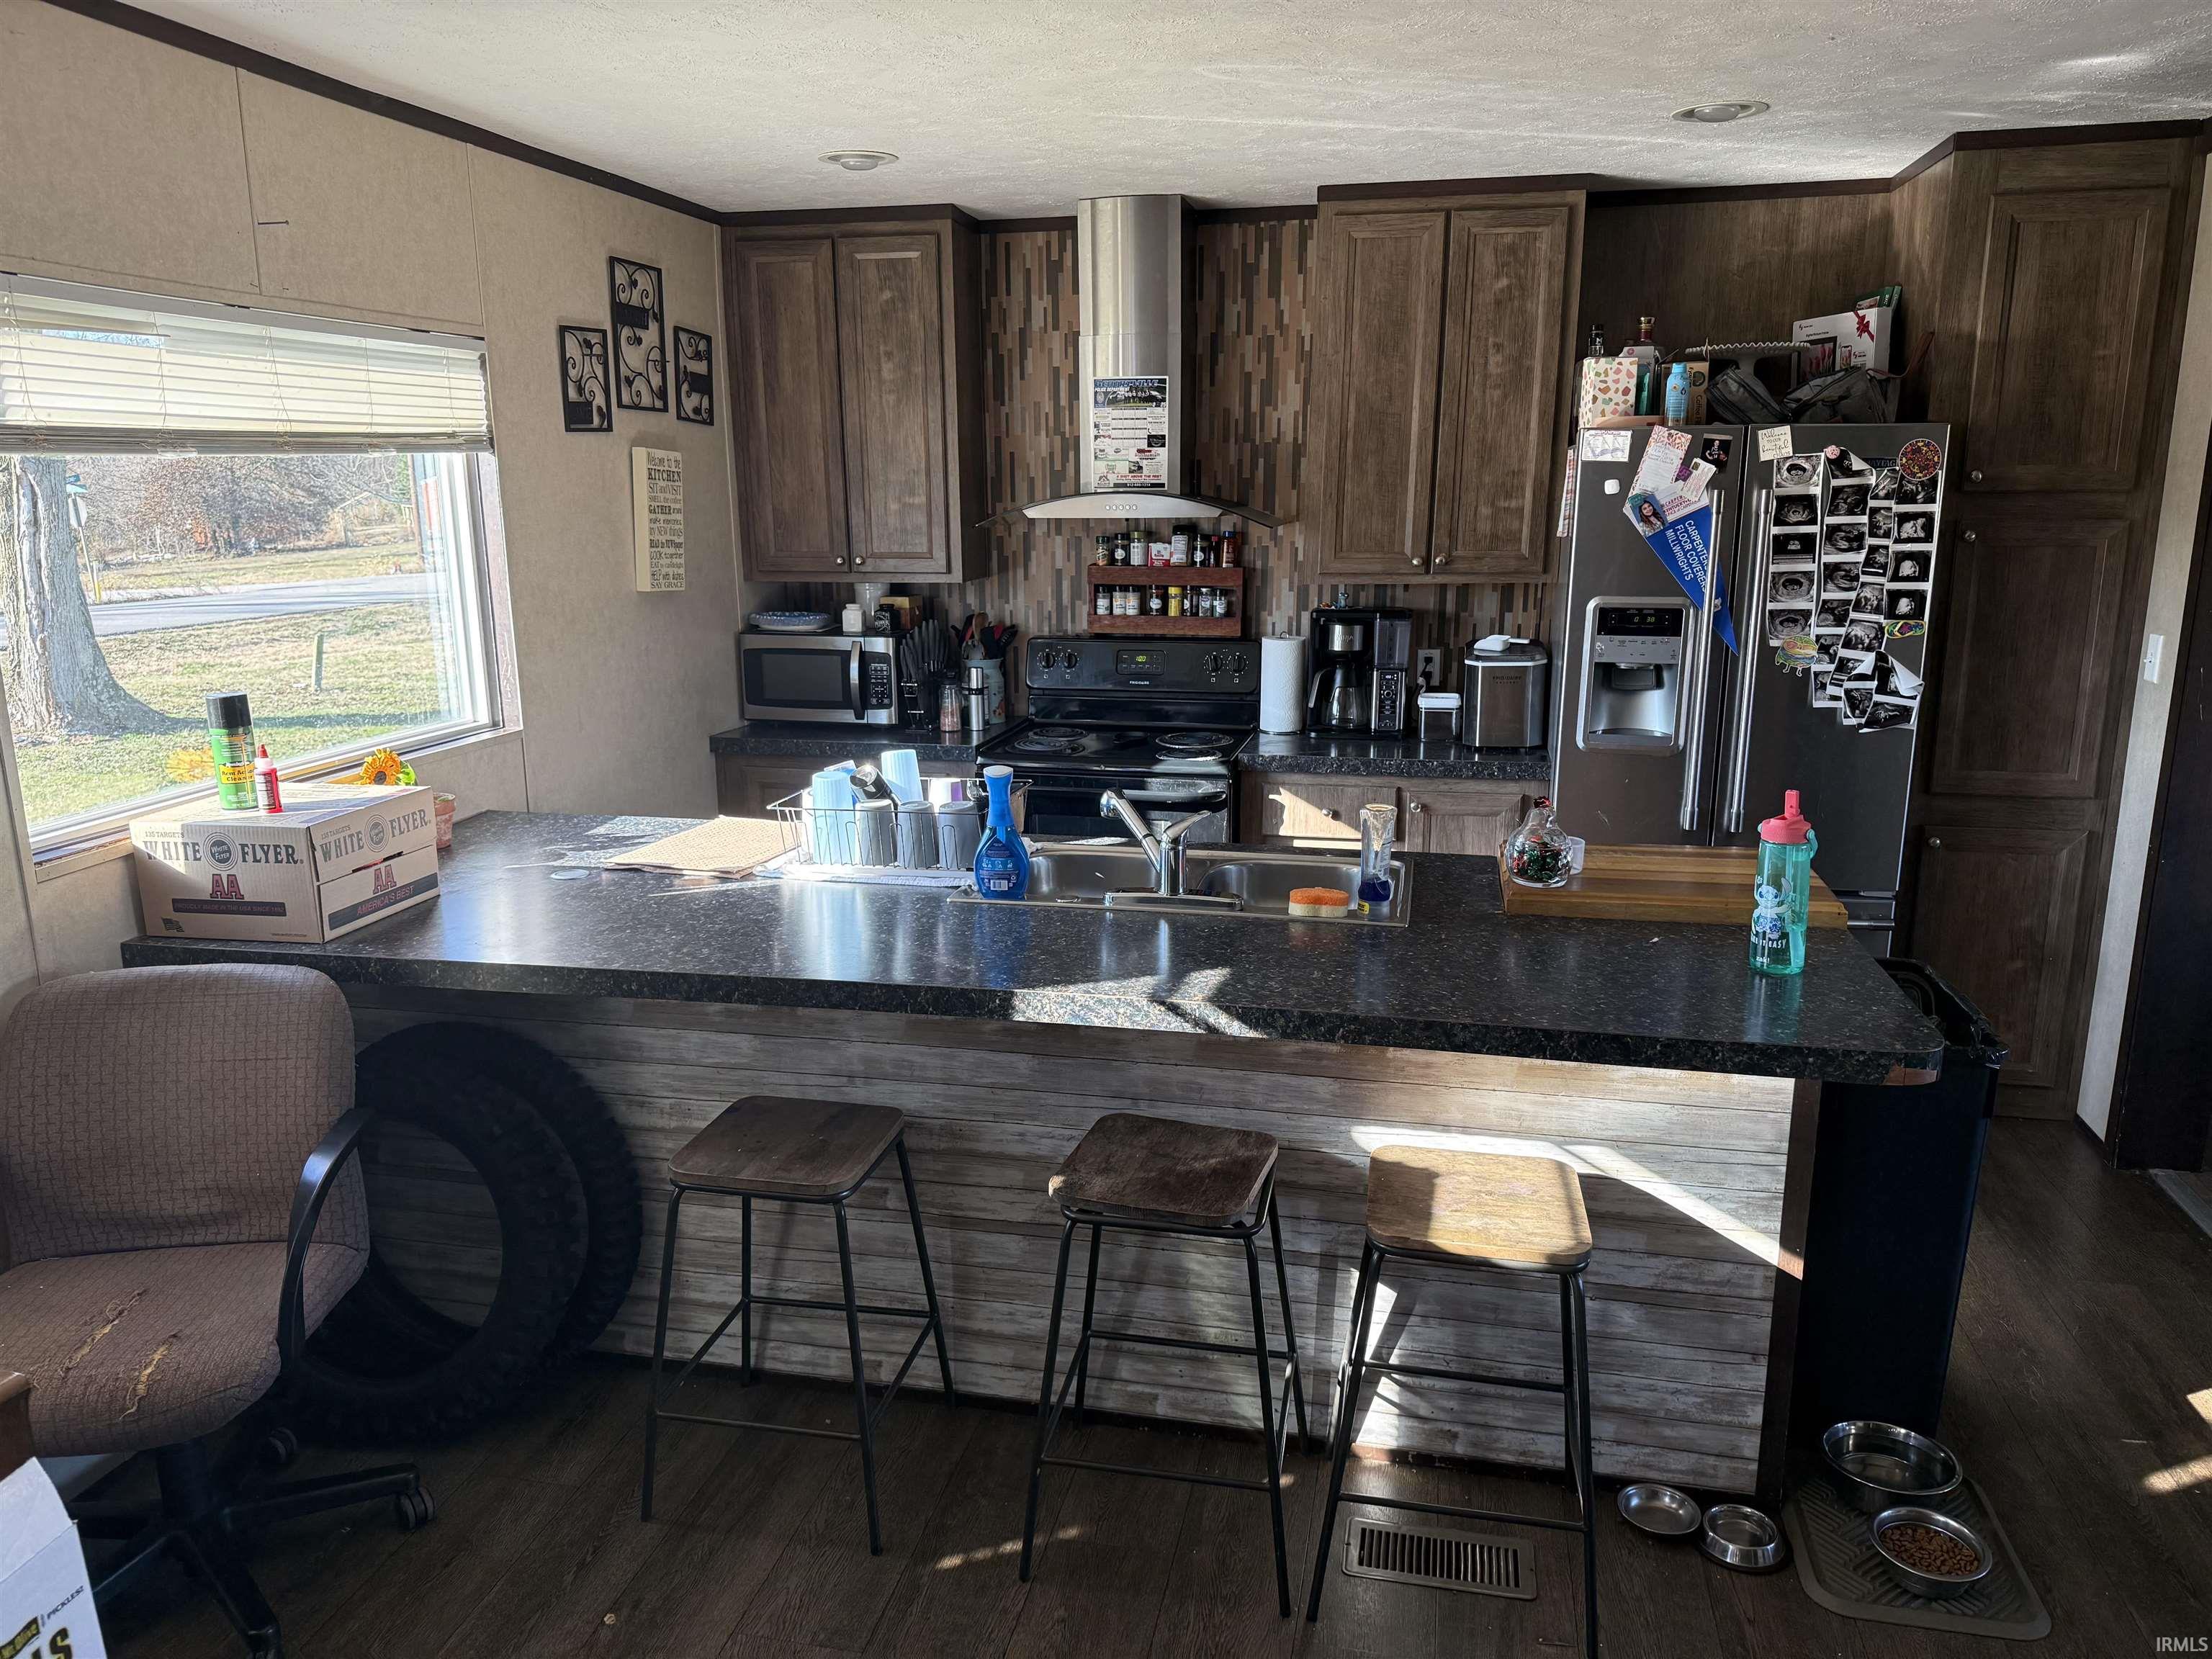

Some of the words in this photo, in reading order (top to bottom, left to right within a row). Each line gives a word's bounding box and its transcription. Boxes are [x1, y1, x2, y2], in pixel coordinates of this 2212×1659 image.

[667, 455, 673, 468] to
[647, 467, 681, 482] KITCHEN
[649, 482, 658, 494] SIT
[667, 483, 682, 496] VISIT
[649, 504, 672, 515] GATHER
[657, 526, 667, 536] NEW
[1675, 524, 1693, 552] FLOOR
[1665, 529, 1694, 581] MILLWRIGHTS
[142, 840, 202, 862] WHITE
[211, 845, 230, 854] WHITE
[319, 830, 365, 864] WHITE
[210, 873, 245, 900] AA
[372, 863, 397, 895] AA
[357, 893, 396, 916] AMERICA'S
[396, 885, 415, 899] BEST
[1768, 939, 1786, 948] EASY
